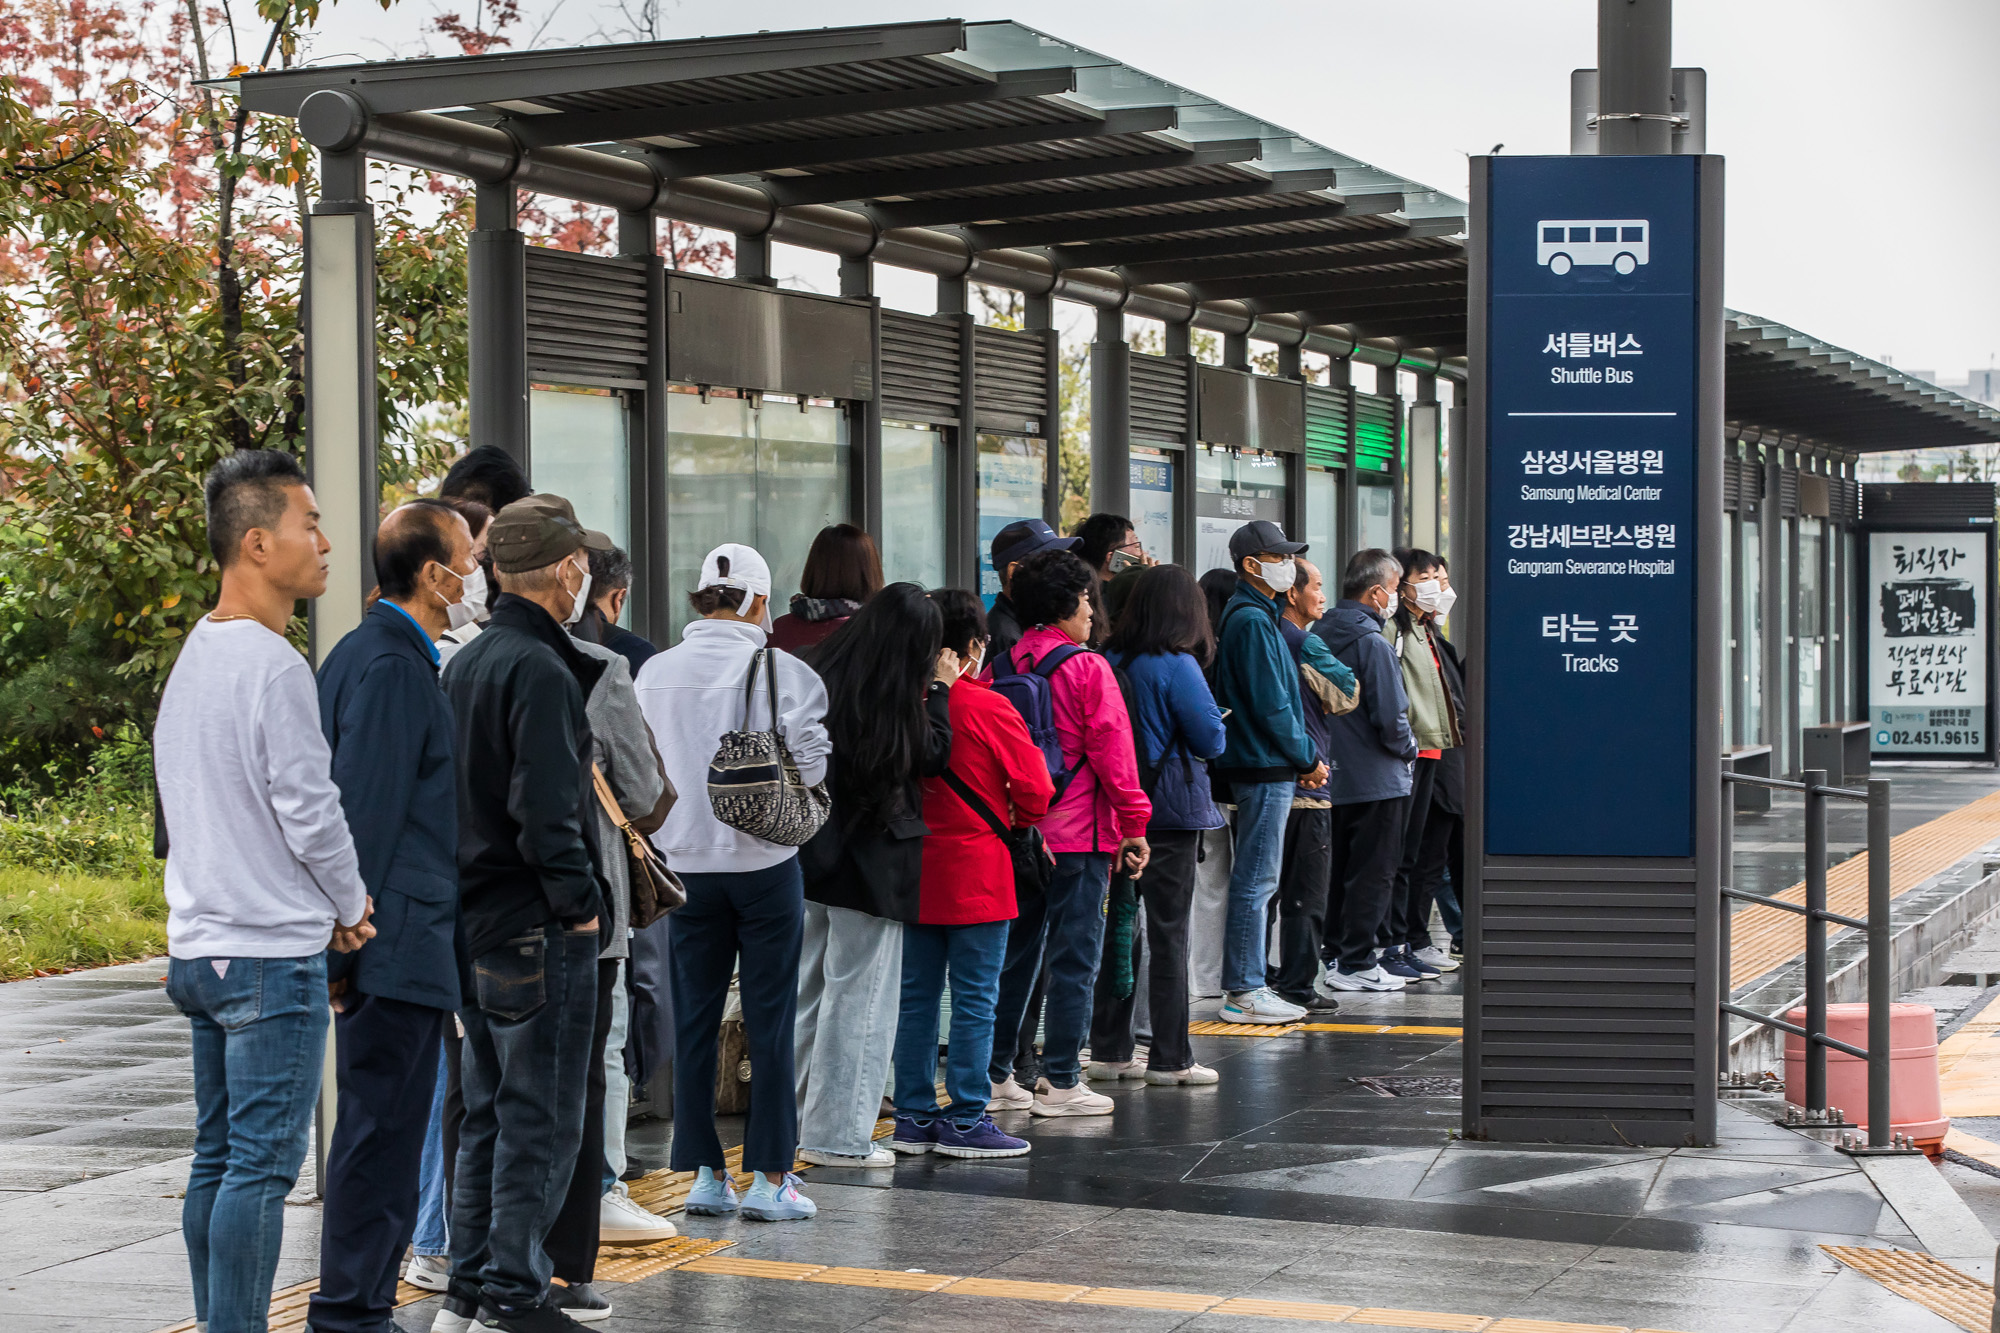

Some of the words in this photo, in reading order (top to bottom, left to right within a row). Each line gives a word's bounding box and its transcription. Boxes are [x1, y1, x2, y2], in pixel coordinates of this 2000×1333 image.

[1542, 332, 1644, 358] 셔틀버스
[1550, 366, 1603, 384] Shuttle
[1605, 366, 1634, 384] Bus
[1520, 449, 1664, 475] 삼성서울병원
[1520, 484, 1575, 504] Samsung
[1576, 484, 1622, 501] Medical
[1623, 484, 1663, 501] Center
[1507, 523, 1676, 550] 강남세브란스병원
[1507, 558, 1564, 578] Gangnam
[1565, 558, 1627, 575] Severance
[1628, 558, 1675, 578] Hospital
[1892, 545, 1966, 575] 퇴직자
[1895, 586, 1936, 610] 폐암
[1542, 613, 1600, 643] 타는
[1608, 614, 1639, 643] 곳
[1897, 605, 1963, 633] 폐질환
[1561, 653, 1620, 674] Tracks
[1885, 668, 1967, 697] 무료상담
[1892, 730, 1980, 745] 02.451.9615
